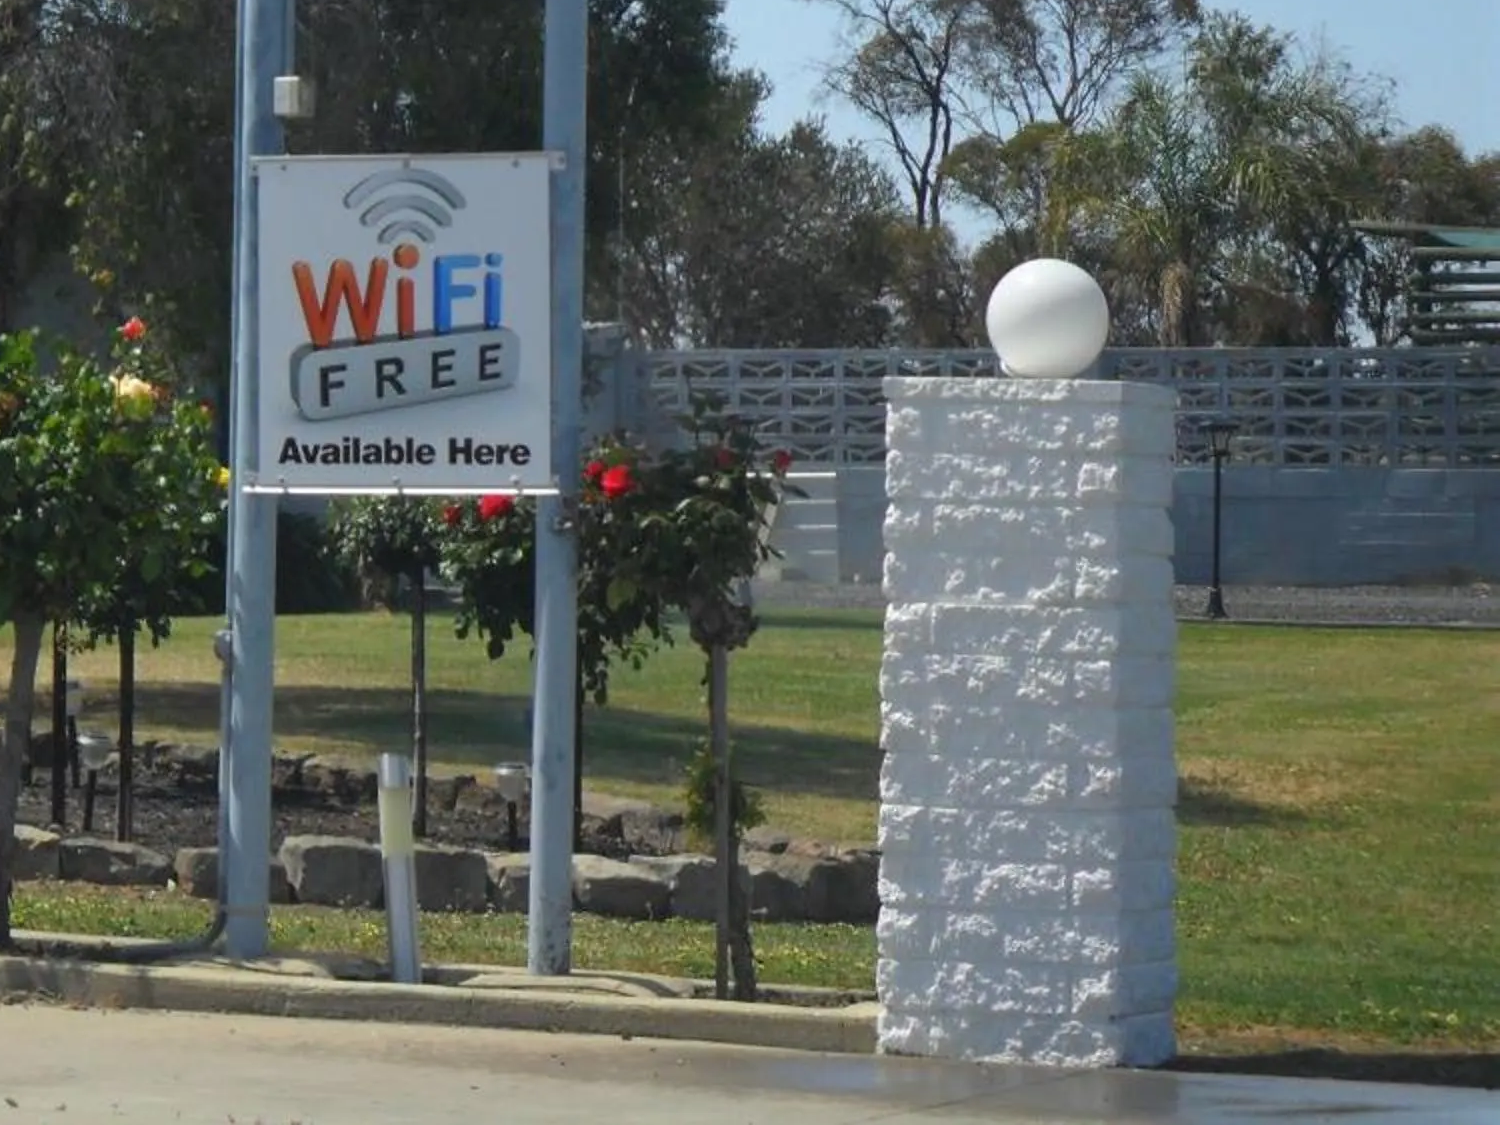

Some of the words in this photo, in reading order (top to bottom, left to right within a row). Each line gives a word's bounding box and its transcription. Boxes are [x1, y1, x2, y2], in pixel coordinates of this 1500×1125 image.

[292, 243, 503, 349] WiFi
[318, 343, 503, 407] FREE
[278, 437, 436, 466] Available
[448, 437, 531, 465] Here
